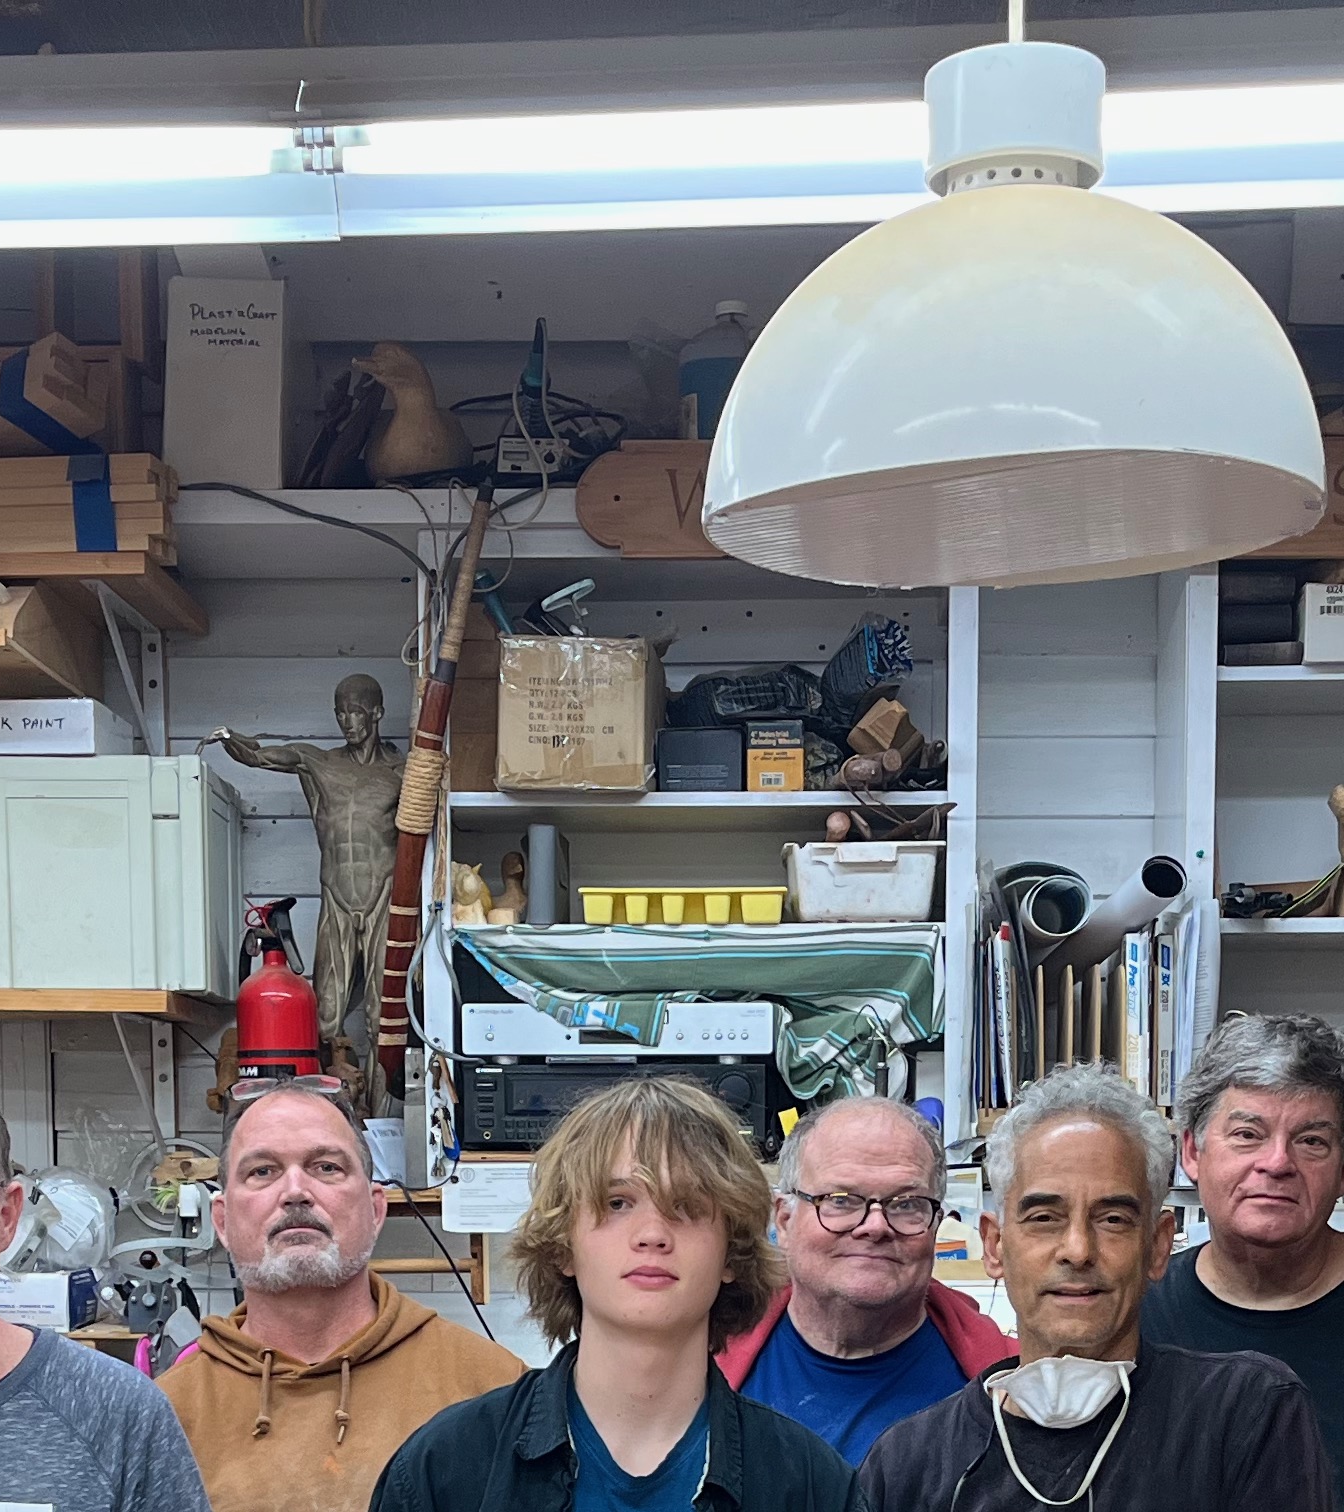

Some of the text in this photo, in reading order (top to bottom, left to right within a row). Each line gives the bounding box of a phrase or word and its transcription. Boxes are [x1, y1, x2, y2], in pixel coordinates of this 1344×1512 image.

[567, 701, 584, 710] KGS
[567, 713, 584, 721] KGS
[22, 717, 66, 730] PAINT
